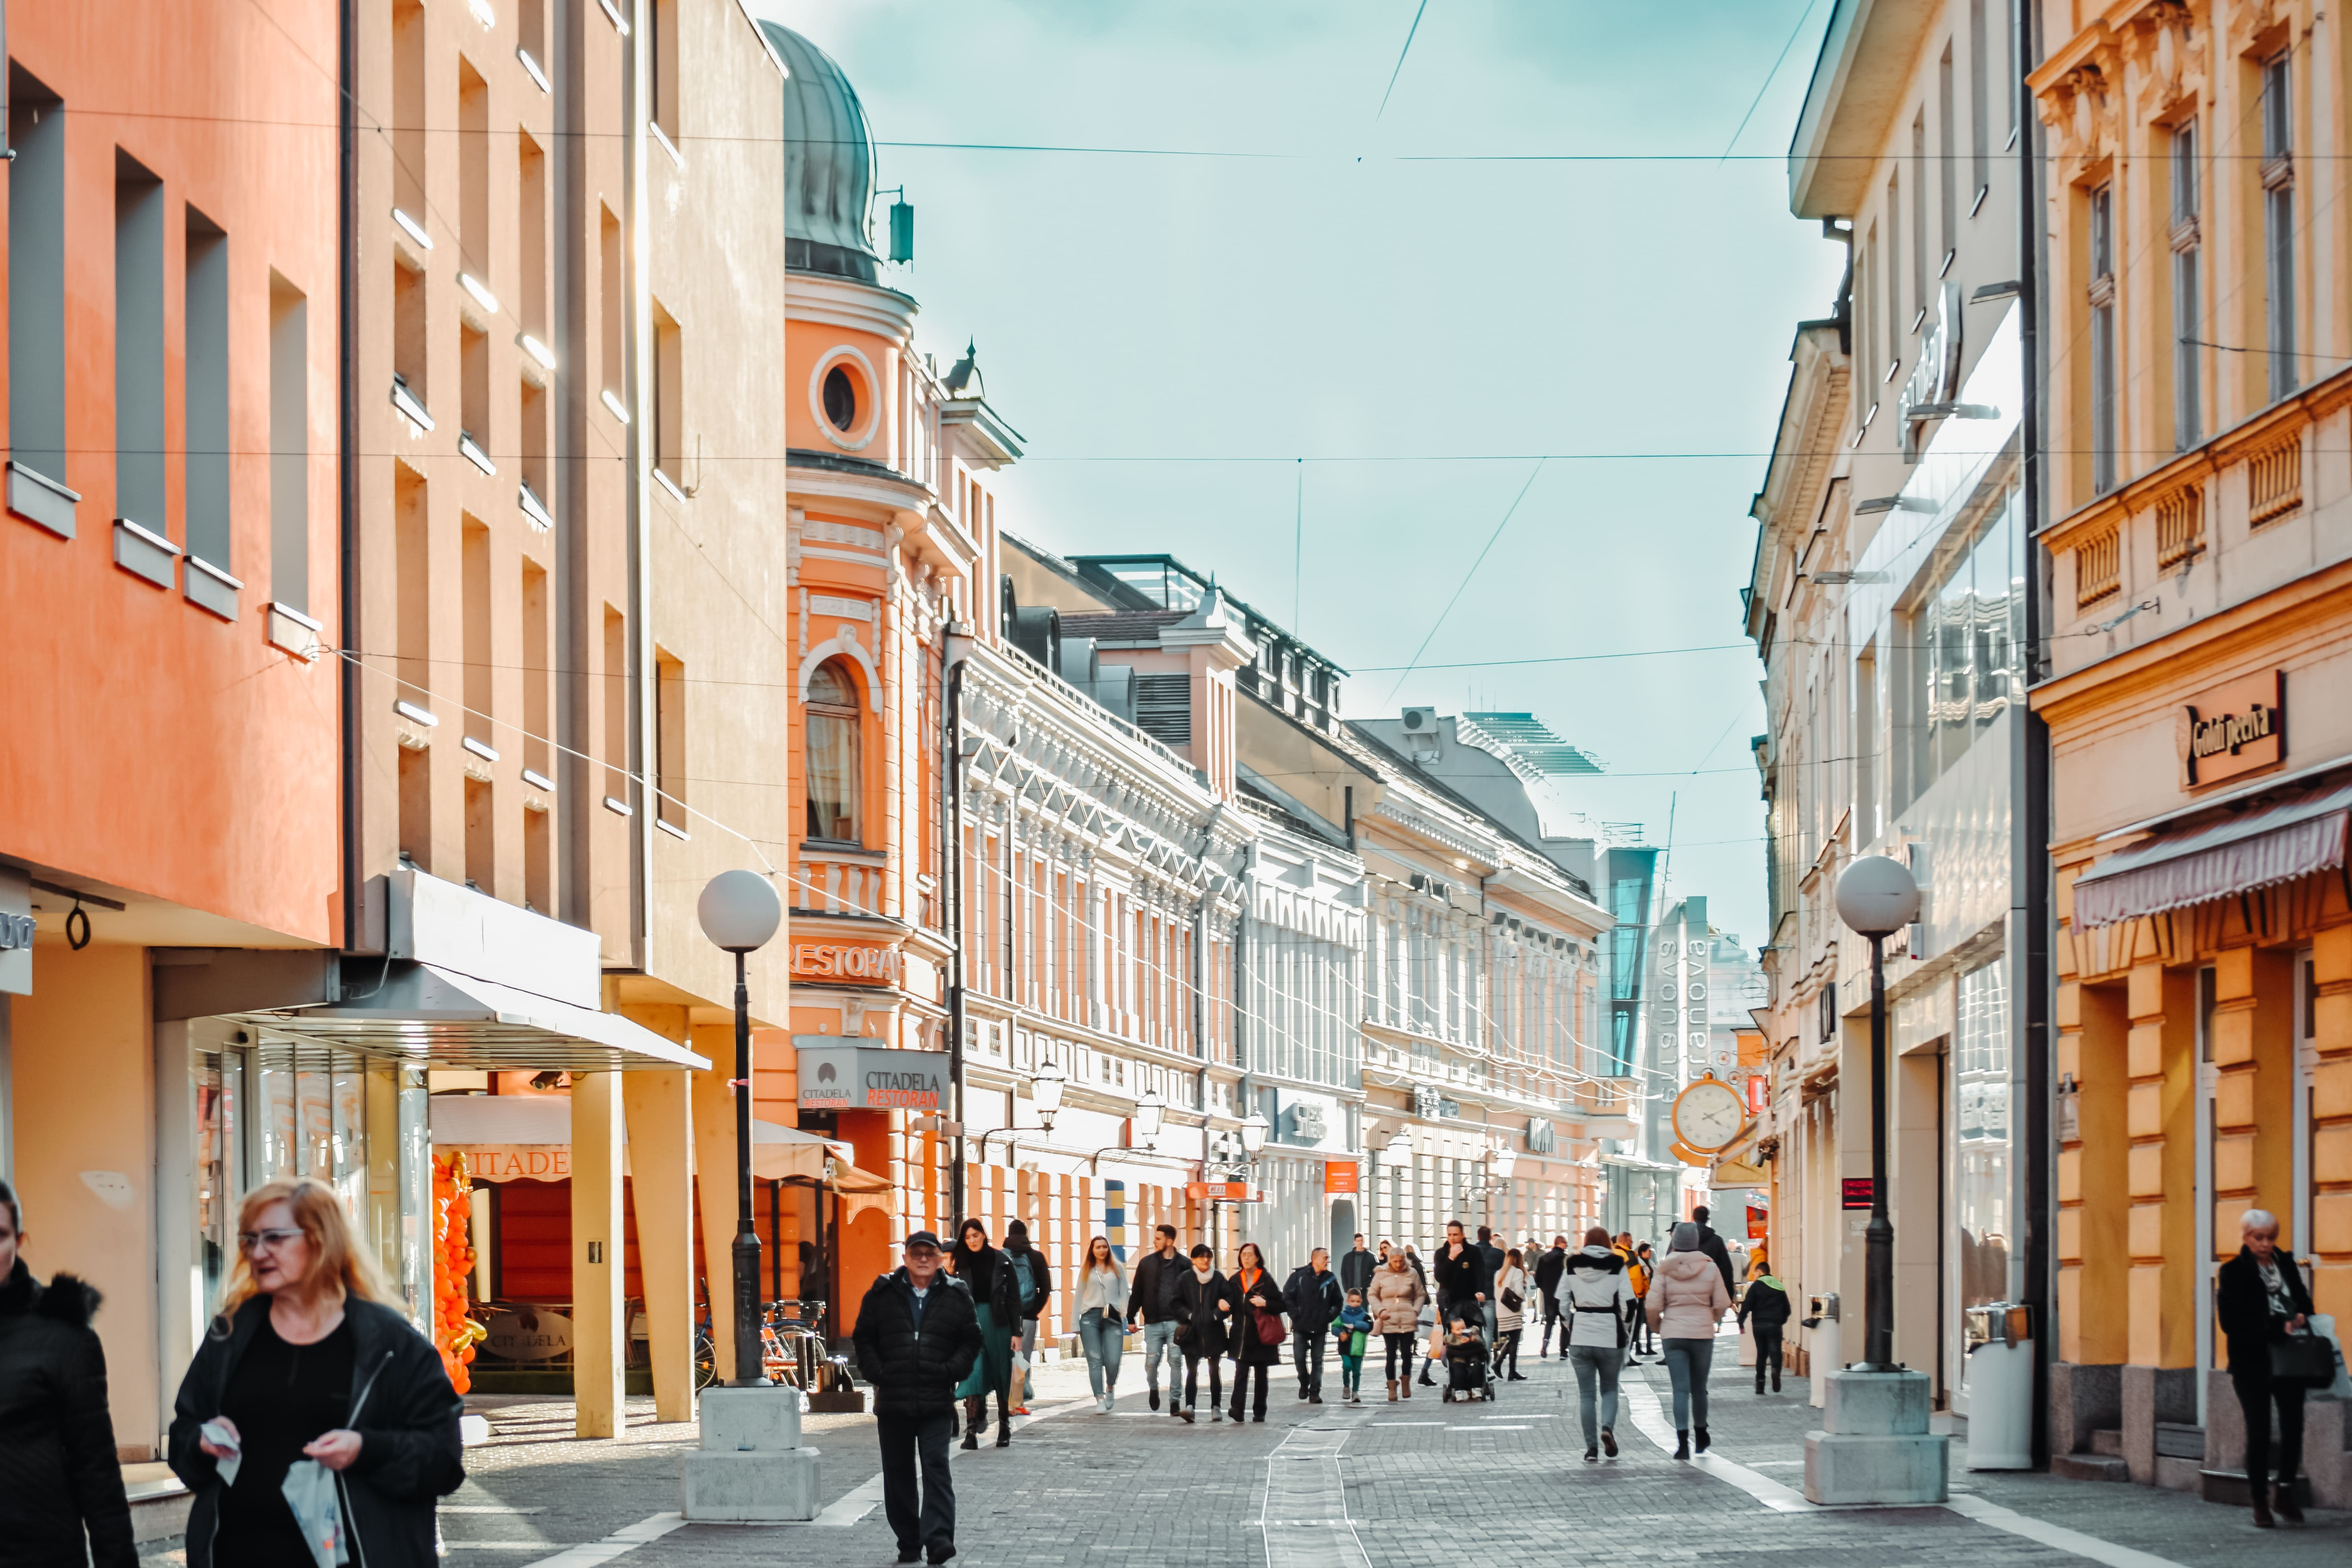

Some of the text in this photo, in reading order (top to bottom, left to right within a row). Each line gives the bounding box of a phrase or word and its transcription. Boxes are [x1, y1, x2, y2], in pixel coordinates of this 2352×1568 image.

[1688, 940, 1706, 1080] rranova
[866, 1071, 940, 1091] CITADELA
[803, 1089, 851, 1099] CITADELA
[804, 1098, 849, 1108] RESTORAN
[867, 1089, 939, 1108] RESTORAN
